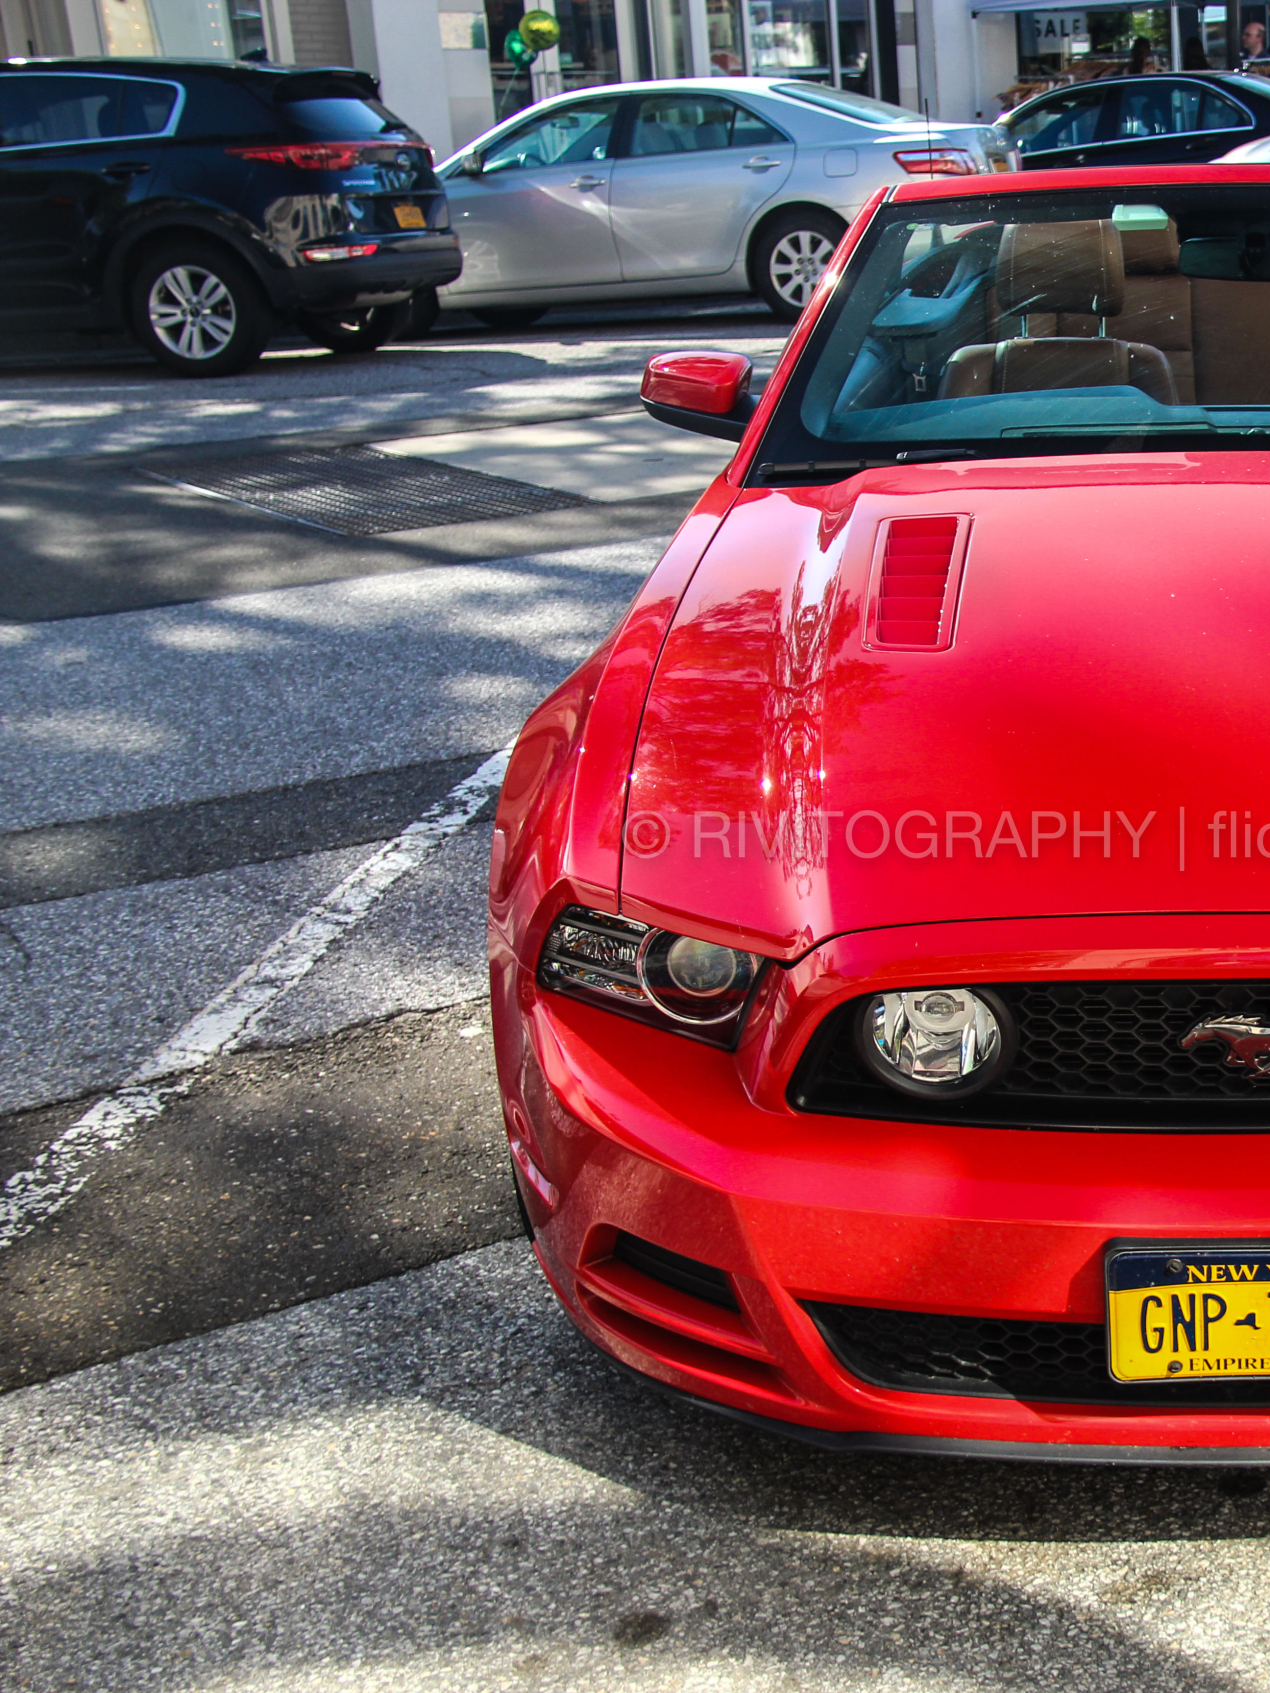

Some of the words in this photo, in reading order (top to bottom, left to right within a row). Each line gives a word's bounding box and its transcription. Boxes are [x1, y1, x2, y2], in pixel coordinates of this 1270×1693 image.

[1034, 18, 1080, 38] SALE
[1186, 1264, 1259, 1283] NEW
[1140, 1293, 1227, 1353] GNP
[1189, 1358, 1270, 1371] EMPIRE
